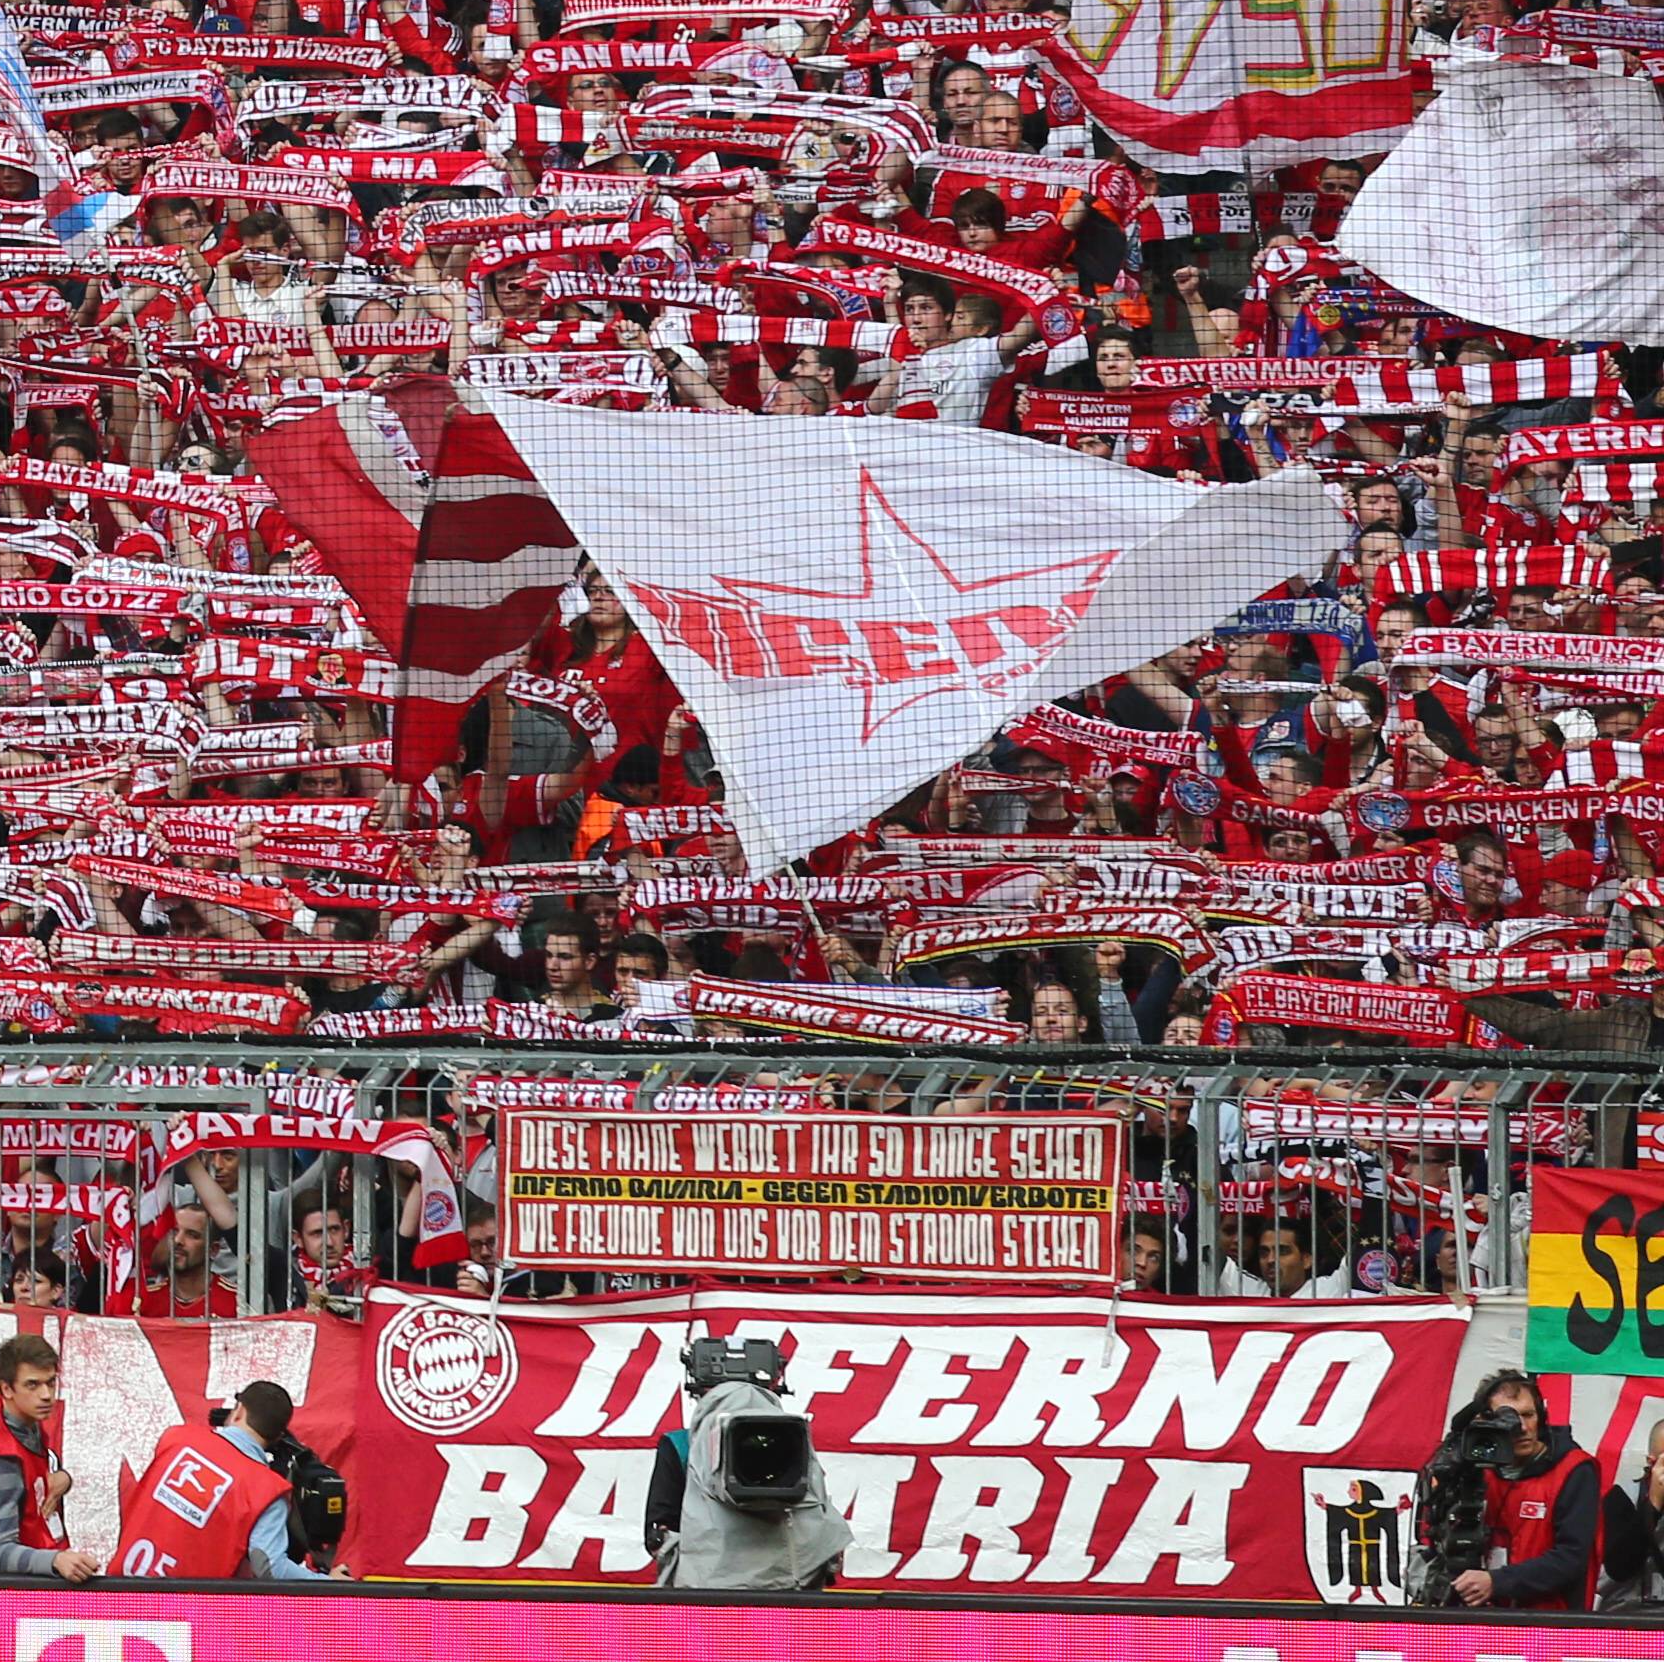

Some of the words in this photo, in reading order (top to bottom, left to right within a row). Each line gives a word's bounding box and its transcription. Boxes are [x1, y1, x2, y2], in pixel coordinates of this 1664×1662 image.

[144, 36, 173, 56] FC
[179, 34, 270, 59] BAYERN
[274, 37, 389, 70] MÜNCHEN
[533, 44, 611, 73] SAN
[619, 42, 693, 69] MIA
[1163, 362, 1257, 385] BAYERN
[1259, 358, 1383, 382] MÜNCHEN
[57, 582, 170, 608] GÖTZE
[1425, 797, 1579, 827] GAISHACKEN
[169, 1113, 383, 1151] BAYERN
[521, 1117, 591, 1171] DIESE
[598, 1119, 689, 1171] FAHNE
[695, 1120, 802, 1174] WERDET
[812, 1123, 862, 1177] IHR
[869, 1124, 905, 1177] SO
[913, 1126, 1001, 1178] LANGE
[1008, 1126, 1104, 1180] SEHEN
[513, 1174, 623, 1198] INFERNO
[764, 1179, 848, 1204] GEGEN
[855, 1182, 1109, 1210] STADIONVERBOTE!
[518, 1202, 561, 1256] WIE
[566, 1203, 667, 1261] FREUNDE
[778, 1204, 825, 1264] VOR
[830, 1205, 883, 1266] DEM
[887, 1213, 994, 1267] STADION
[1002, 1215, 1101, 1270] STEHEN
[388, 1364, 471, 1420] MÜNCHEN
[406, 1442, 1252, 1588] BAARIA
